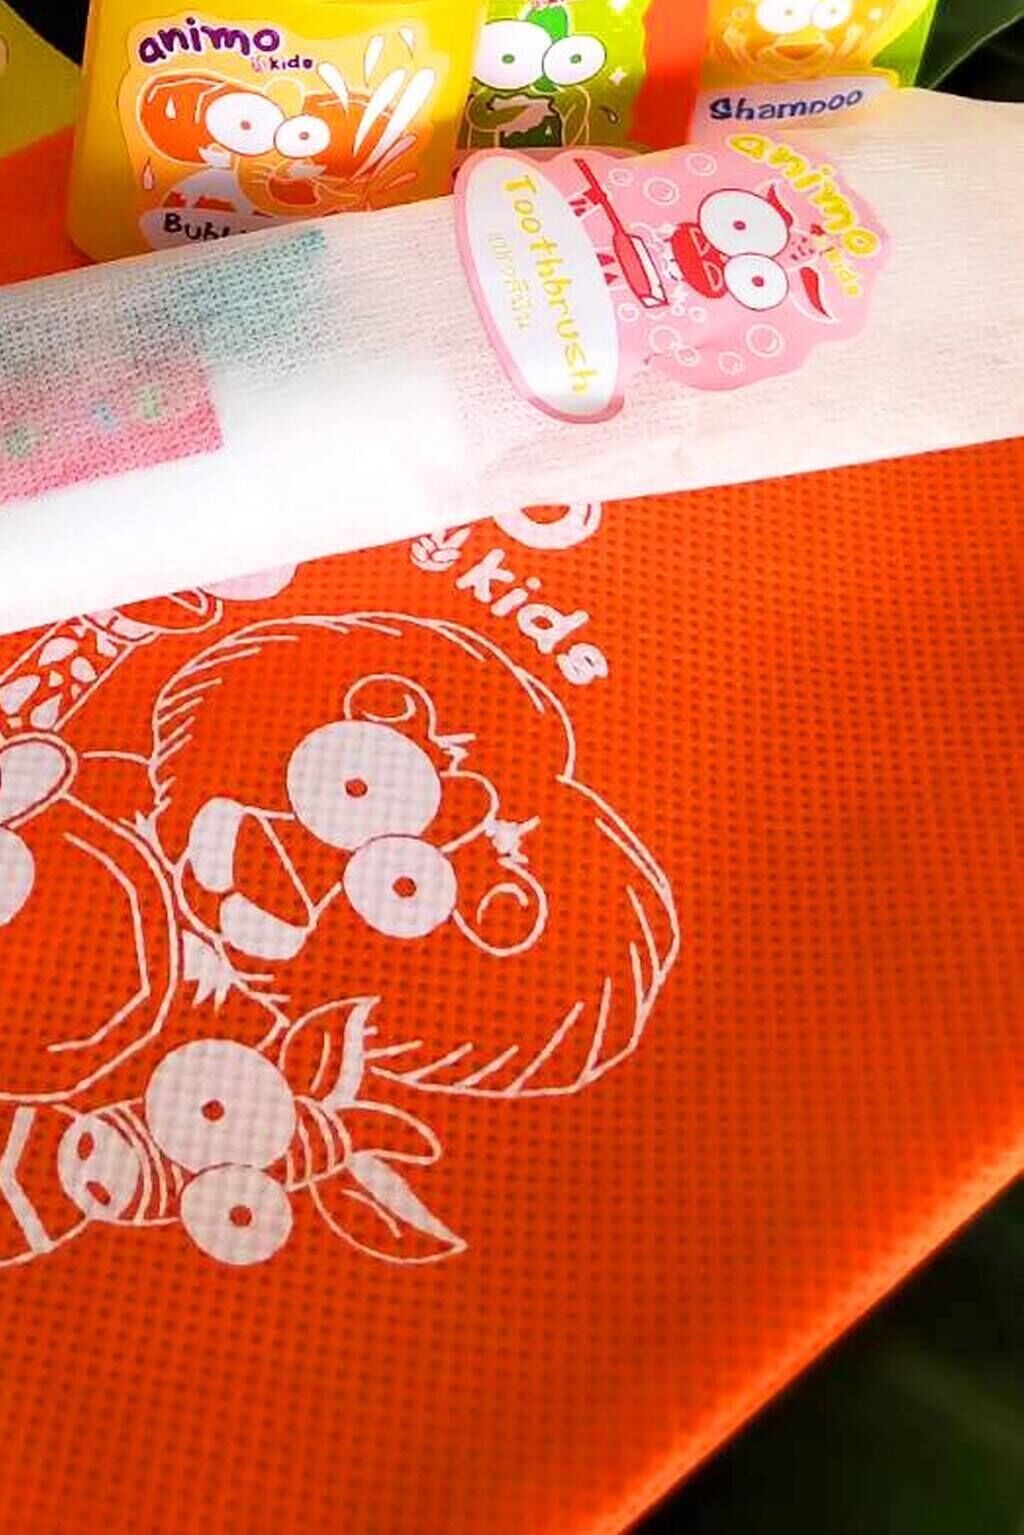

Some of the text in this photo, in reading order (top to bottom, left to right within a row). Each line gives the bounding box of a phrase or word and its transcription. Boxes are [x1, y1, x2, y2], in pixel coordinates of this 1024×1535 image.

[138, 17, 281, 64] animo
[268, 54, 314, 70] kids
[729, 135, 878, 255] animo
[502, 175, 598, 394] Toothbrush
[455, 548, 609, 686] kids
